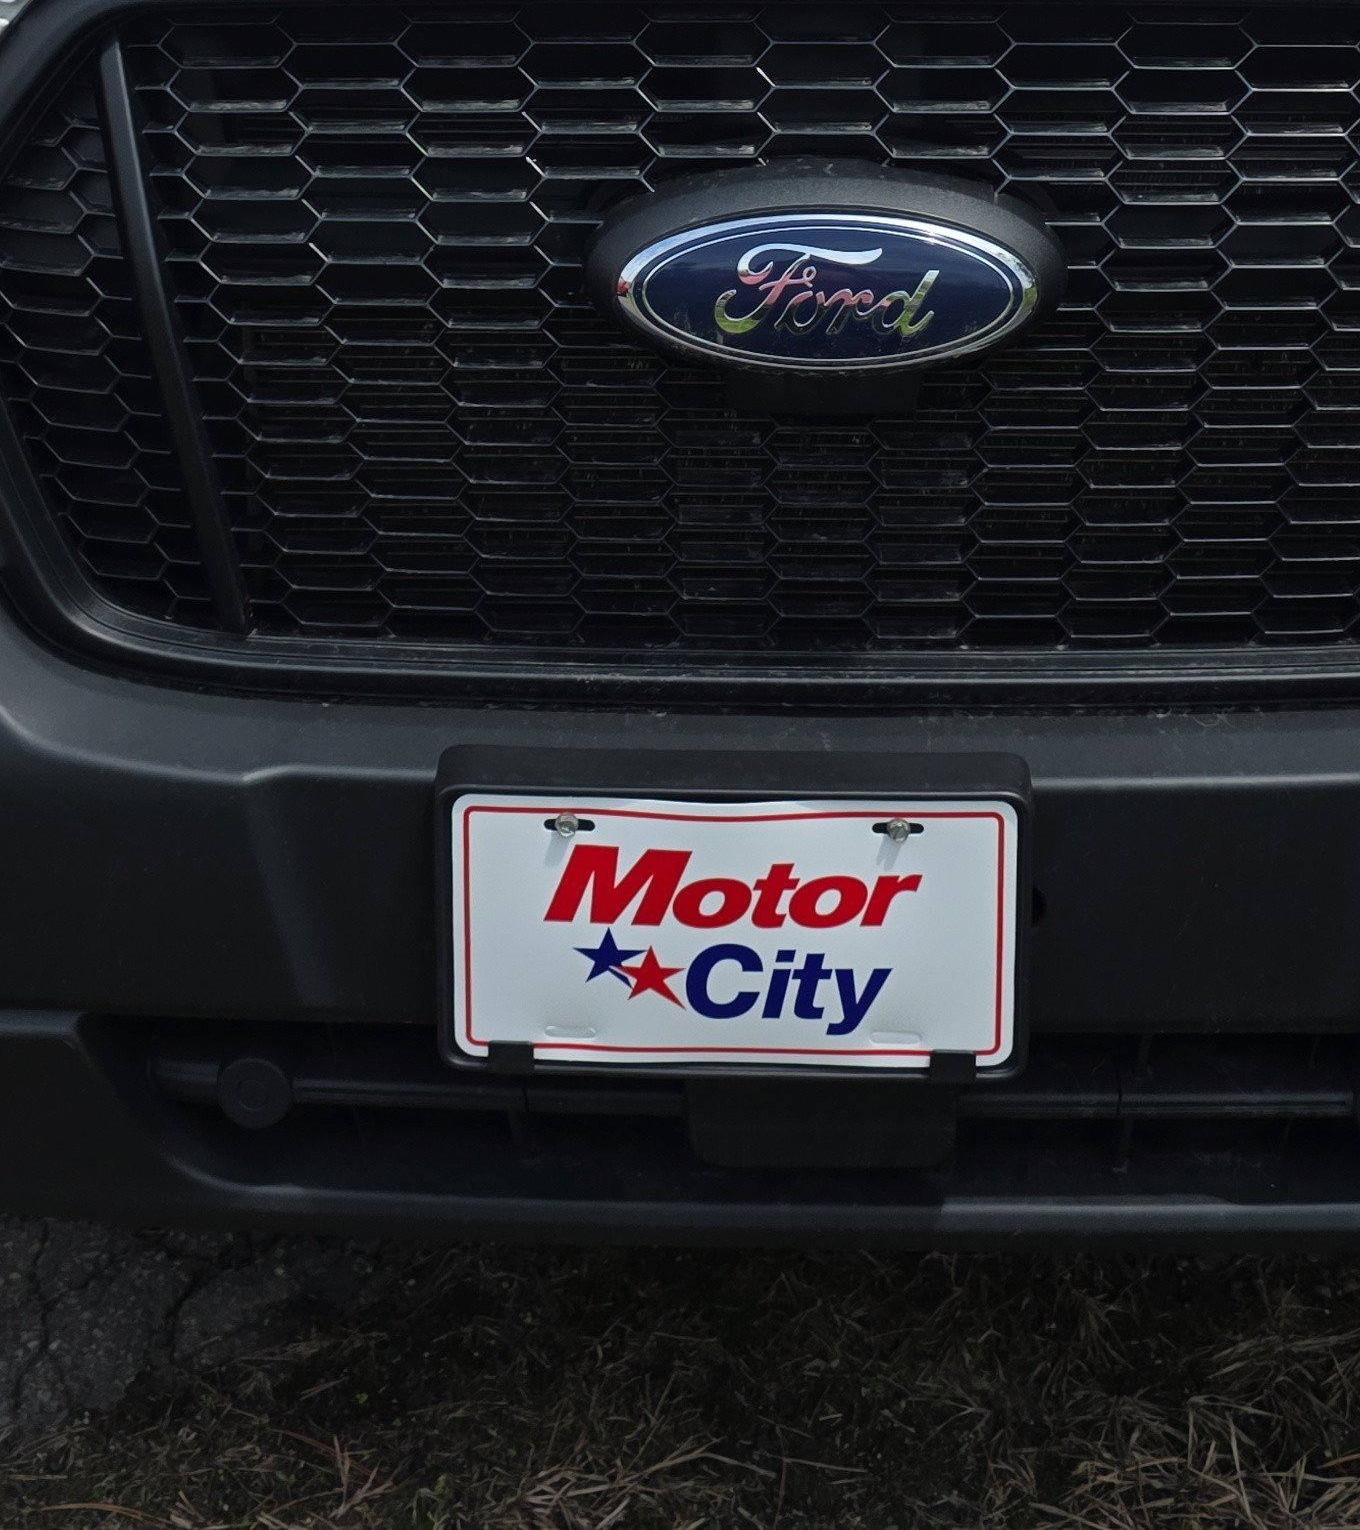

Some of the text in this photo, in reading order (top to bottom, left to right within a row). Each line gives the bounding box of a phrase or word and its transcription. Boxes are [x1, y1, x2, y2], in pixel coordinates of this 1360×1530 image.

[713, 242, 941, 336] Ford
[542, 844, 924, 929] Motor
[684, 942, 894, 1037] City
